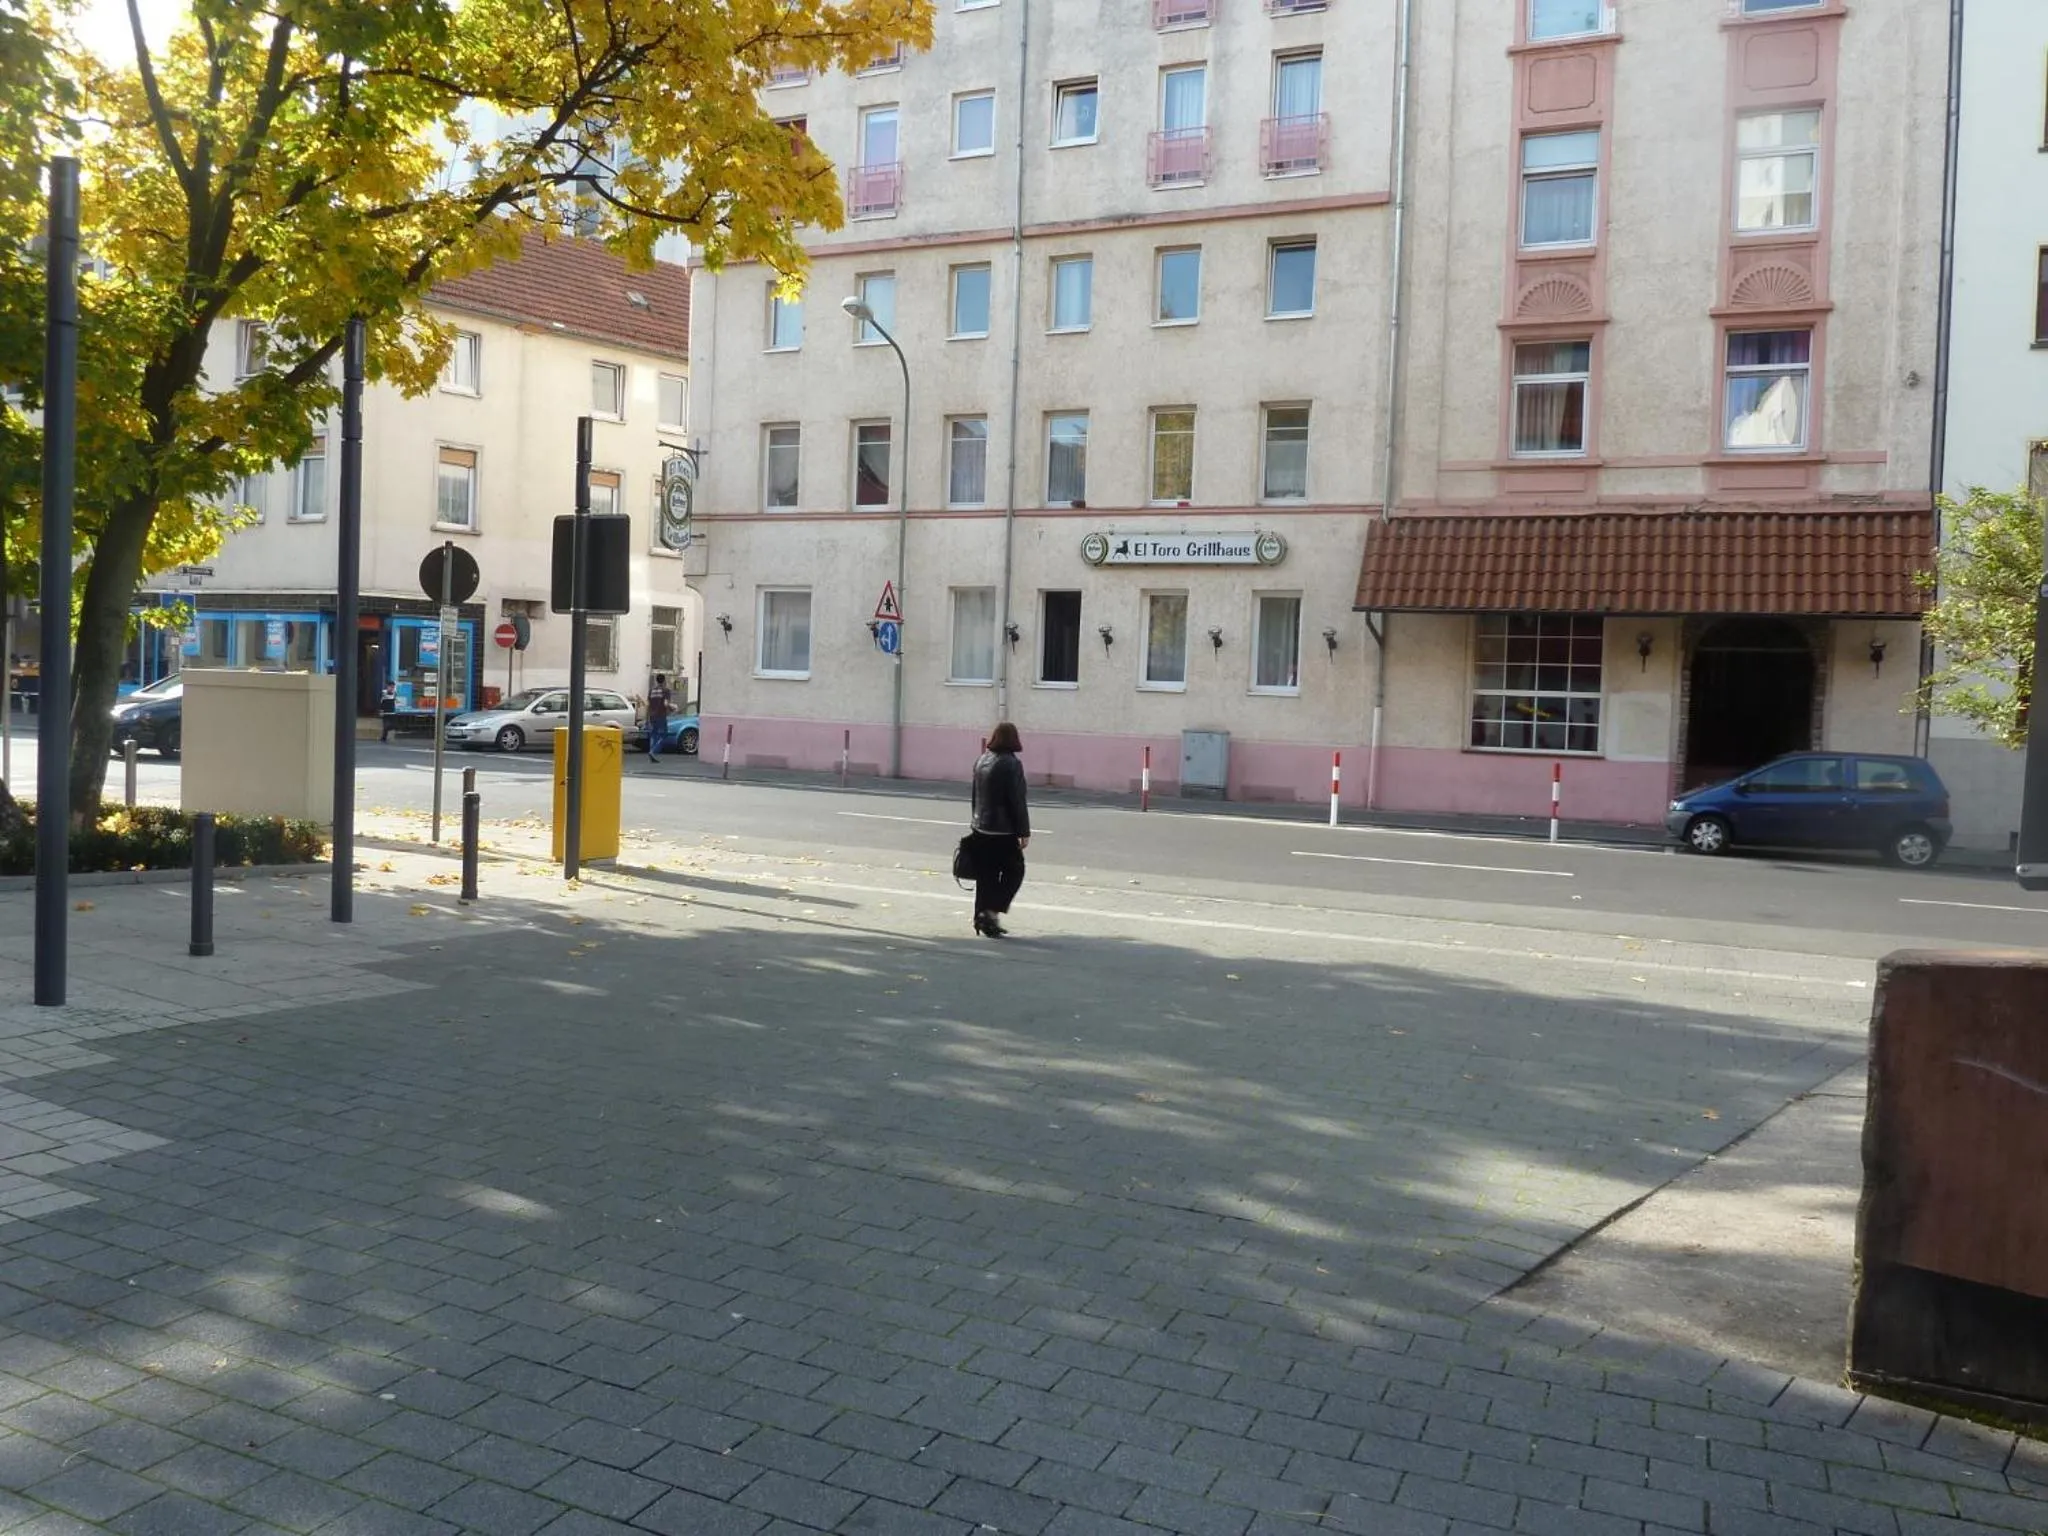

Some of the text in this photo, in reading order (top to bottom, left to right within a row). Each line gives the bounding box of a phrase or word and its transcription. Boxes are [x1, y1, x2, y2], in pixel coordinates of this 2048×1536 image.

[1134, 542, 1147, 557] El
[1151, 542, 1181, 557] Toro
[1186, 541, 1251, 557] Grillhaus
